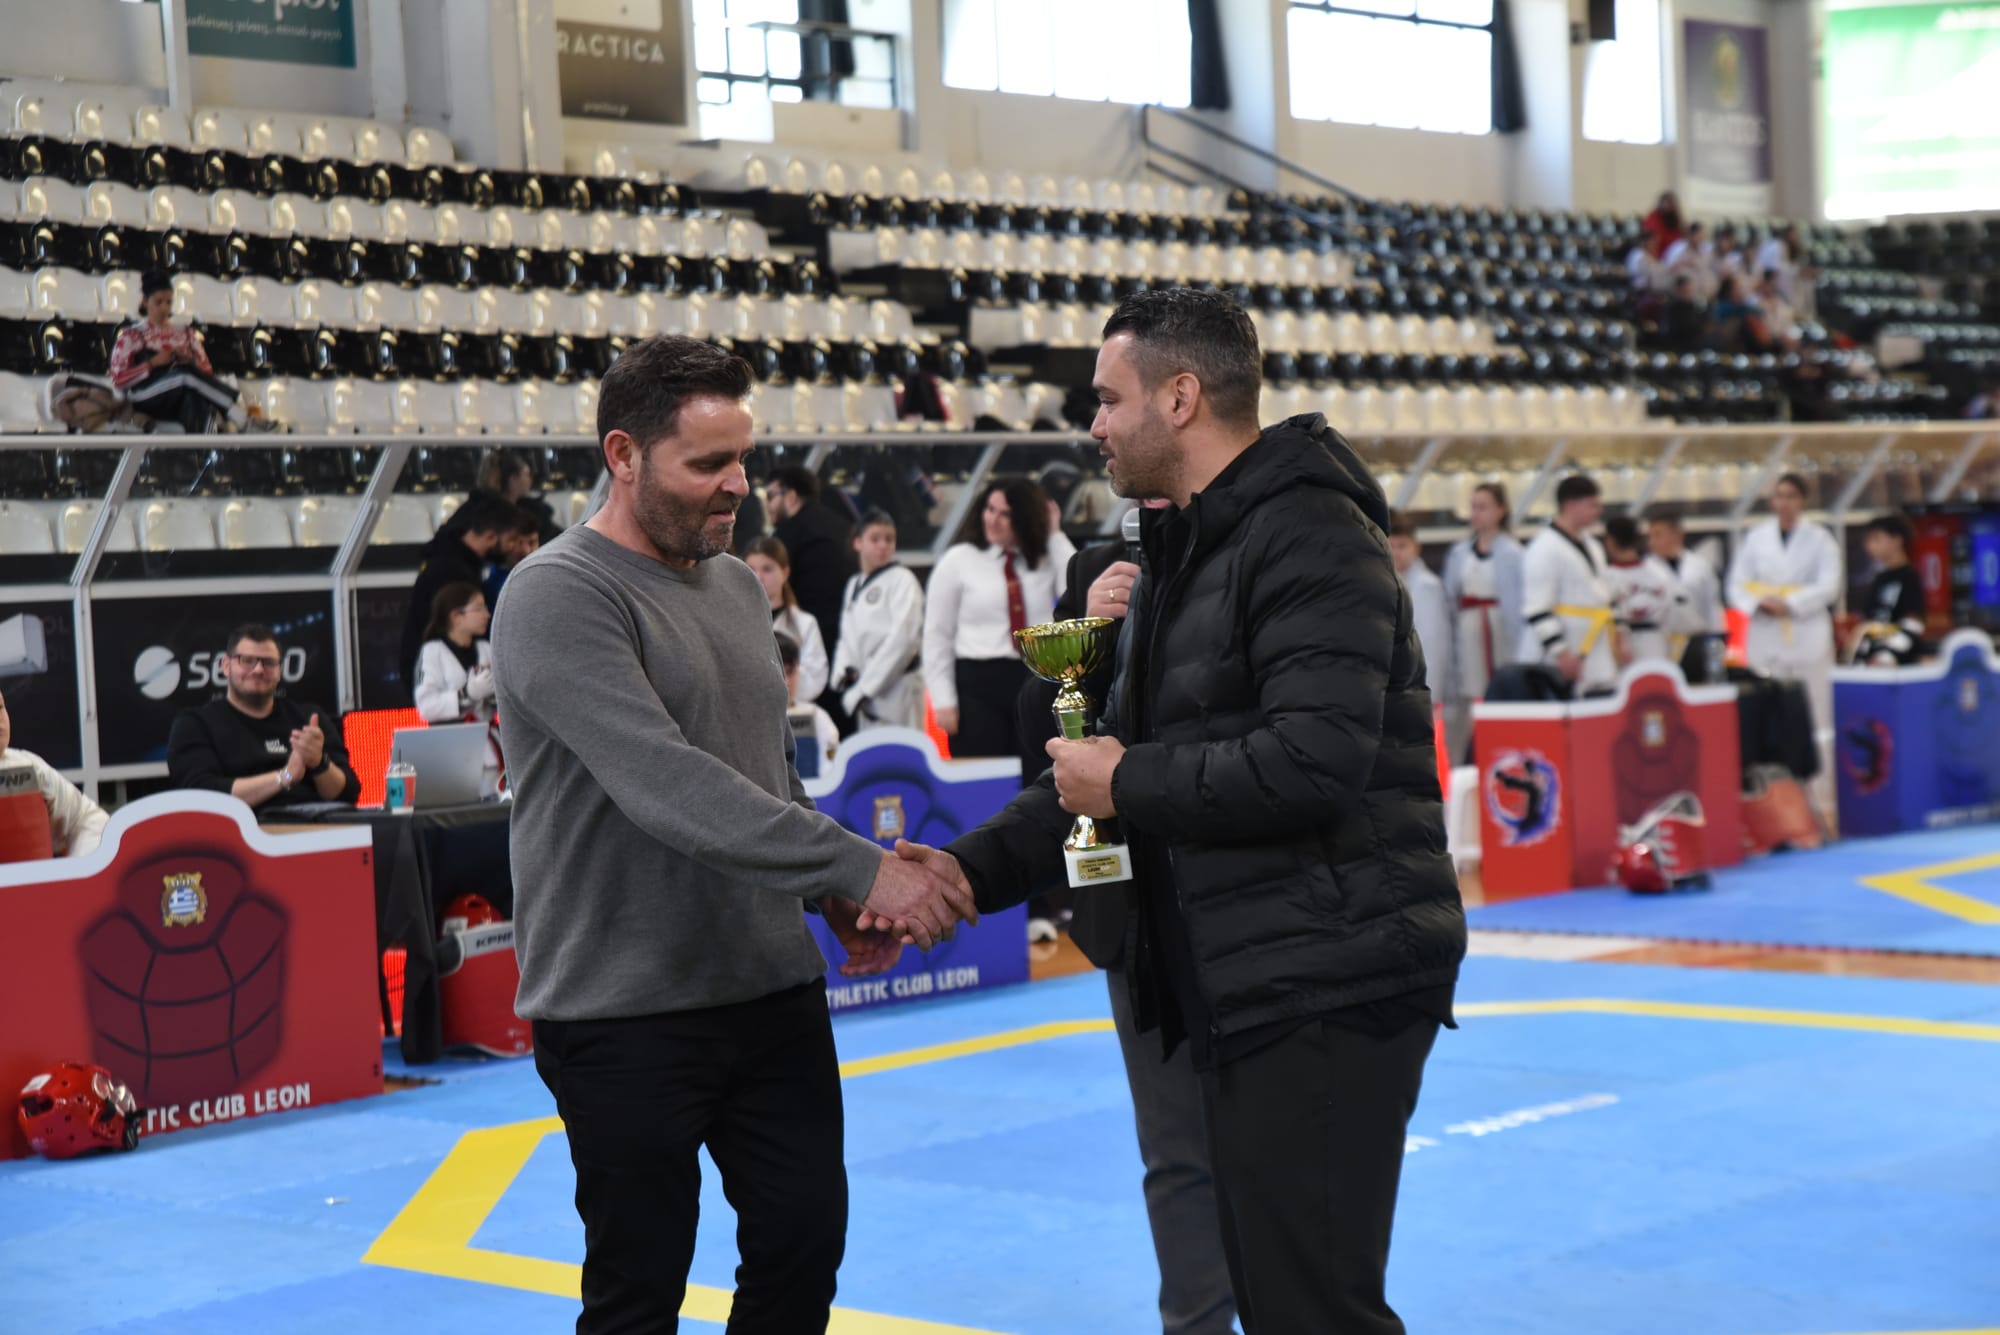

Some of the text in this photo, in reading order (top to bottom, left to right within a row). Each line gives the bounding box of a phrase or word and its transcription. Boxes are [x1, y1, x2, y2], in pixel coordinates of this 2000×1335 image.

[891, 973, 934, 998] CLUB
[937, 965, 979, 992] LEON
[188, 1094, 246, 1124] CLUB
[254, 1082, 311, 1114] LEON
